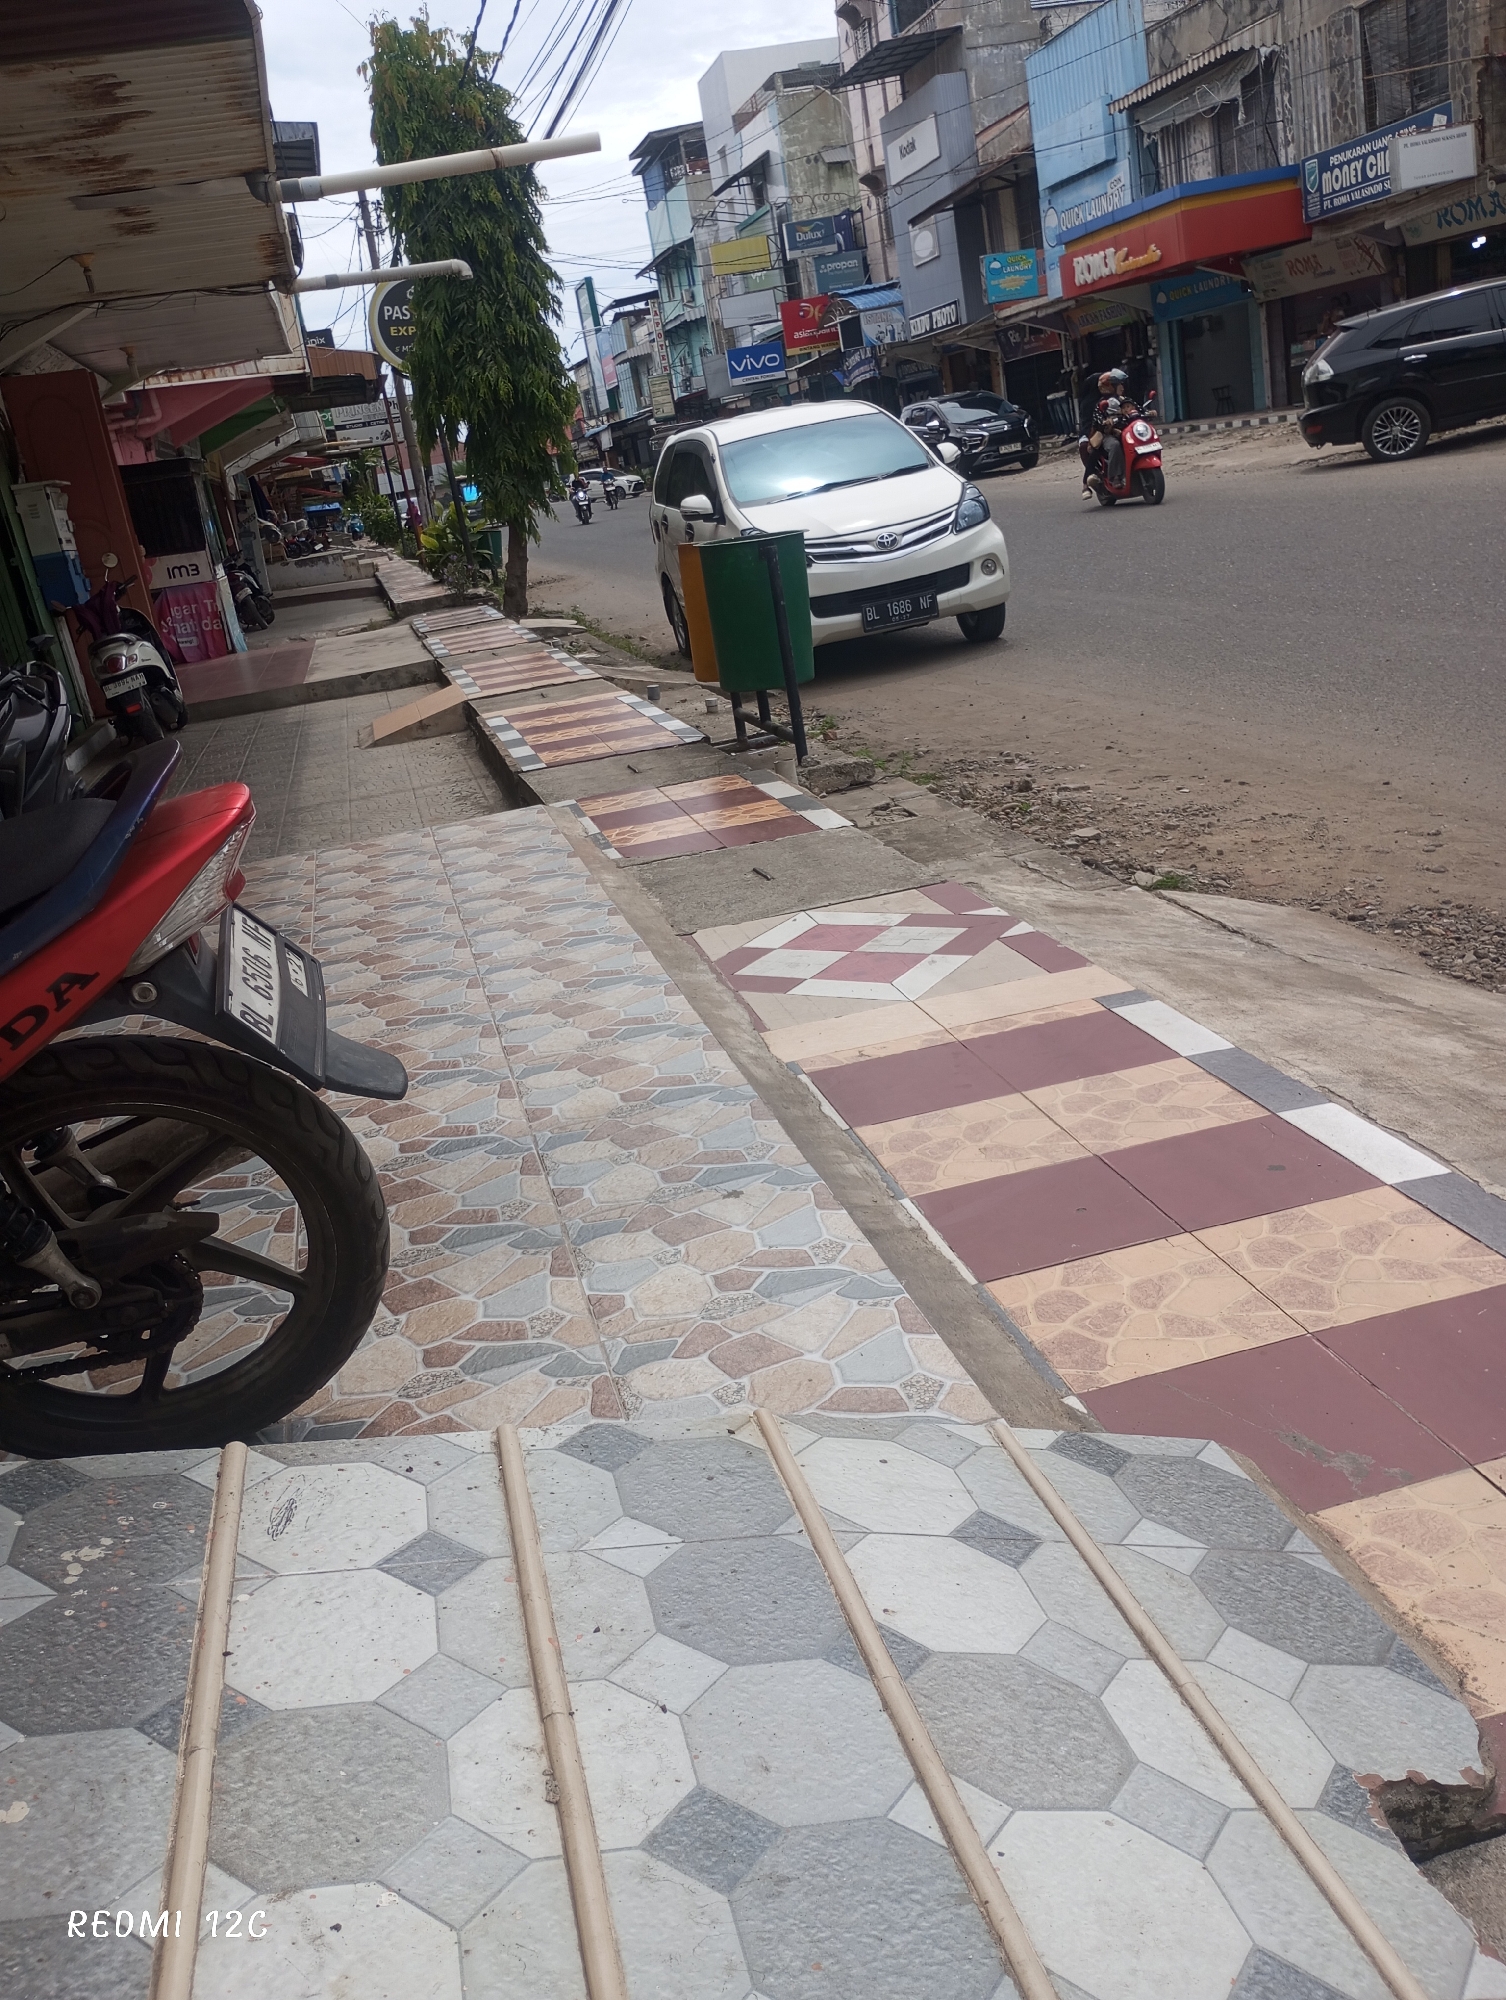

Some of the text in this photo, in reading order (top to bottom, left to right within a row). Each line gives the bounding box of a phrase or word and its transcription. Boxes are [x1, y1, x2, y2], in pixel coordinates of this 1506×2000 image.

[898, 137, 917, 161] Kodak
[1329, 141, 1372, 167] PENUKARAN
[1371, 134, 1393, 151] UANG
[1108, 175, 1122, 190] COIN
[1321, 158, 1363, 195] MONEY
[1333, 194, 1351, 207] ROMA
[1351, 184, 1383, 201] VALASINDO
[1060, 185, 1126, 231] QUICK LAUNDRY
[796, 231, 822, 242] Dulux
[826, 259, 859, 272] propan
[1007, 254, 1027, 263] QUICK
[1285, 254, 1323, 277] ROMA
[1169, 275, 1231, 301] QUICK LAUNDRY
[383, 305, 411, 321] PAS
[864, 311, 894, 326] ISTANA
[931, 304, 957, 329] PHOTO
[390, 326, 417, 336] EXP
[652, 310, 670, 373] APOTEK
[731, 353, 781, 372] vivo
[866, 594, 933, 621] BL 1686 NF
[241, 917, 272, 951] NF
[239, 1002, 274, 1039] BL
